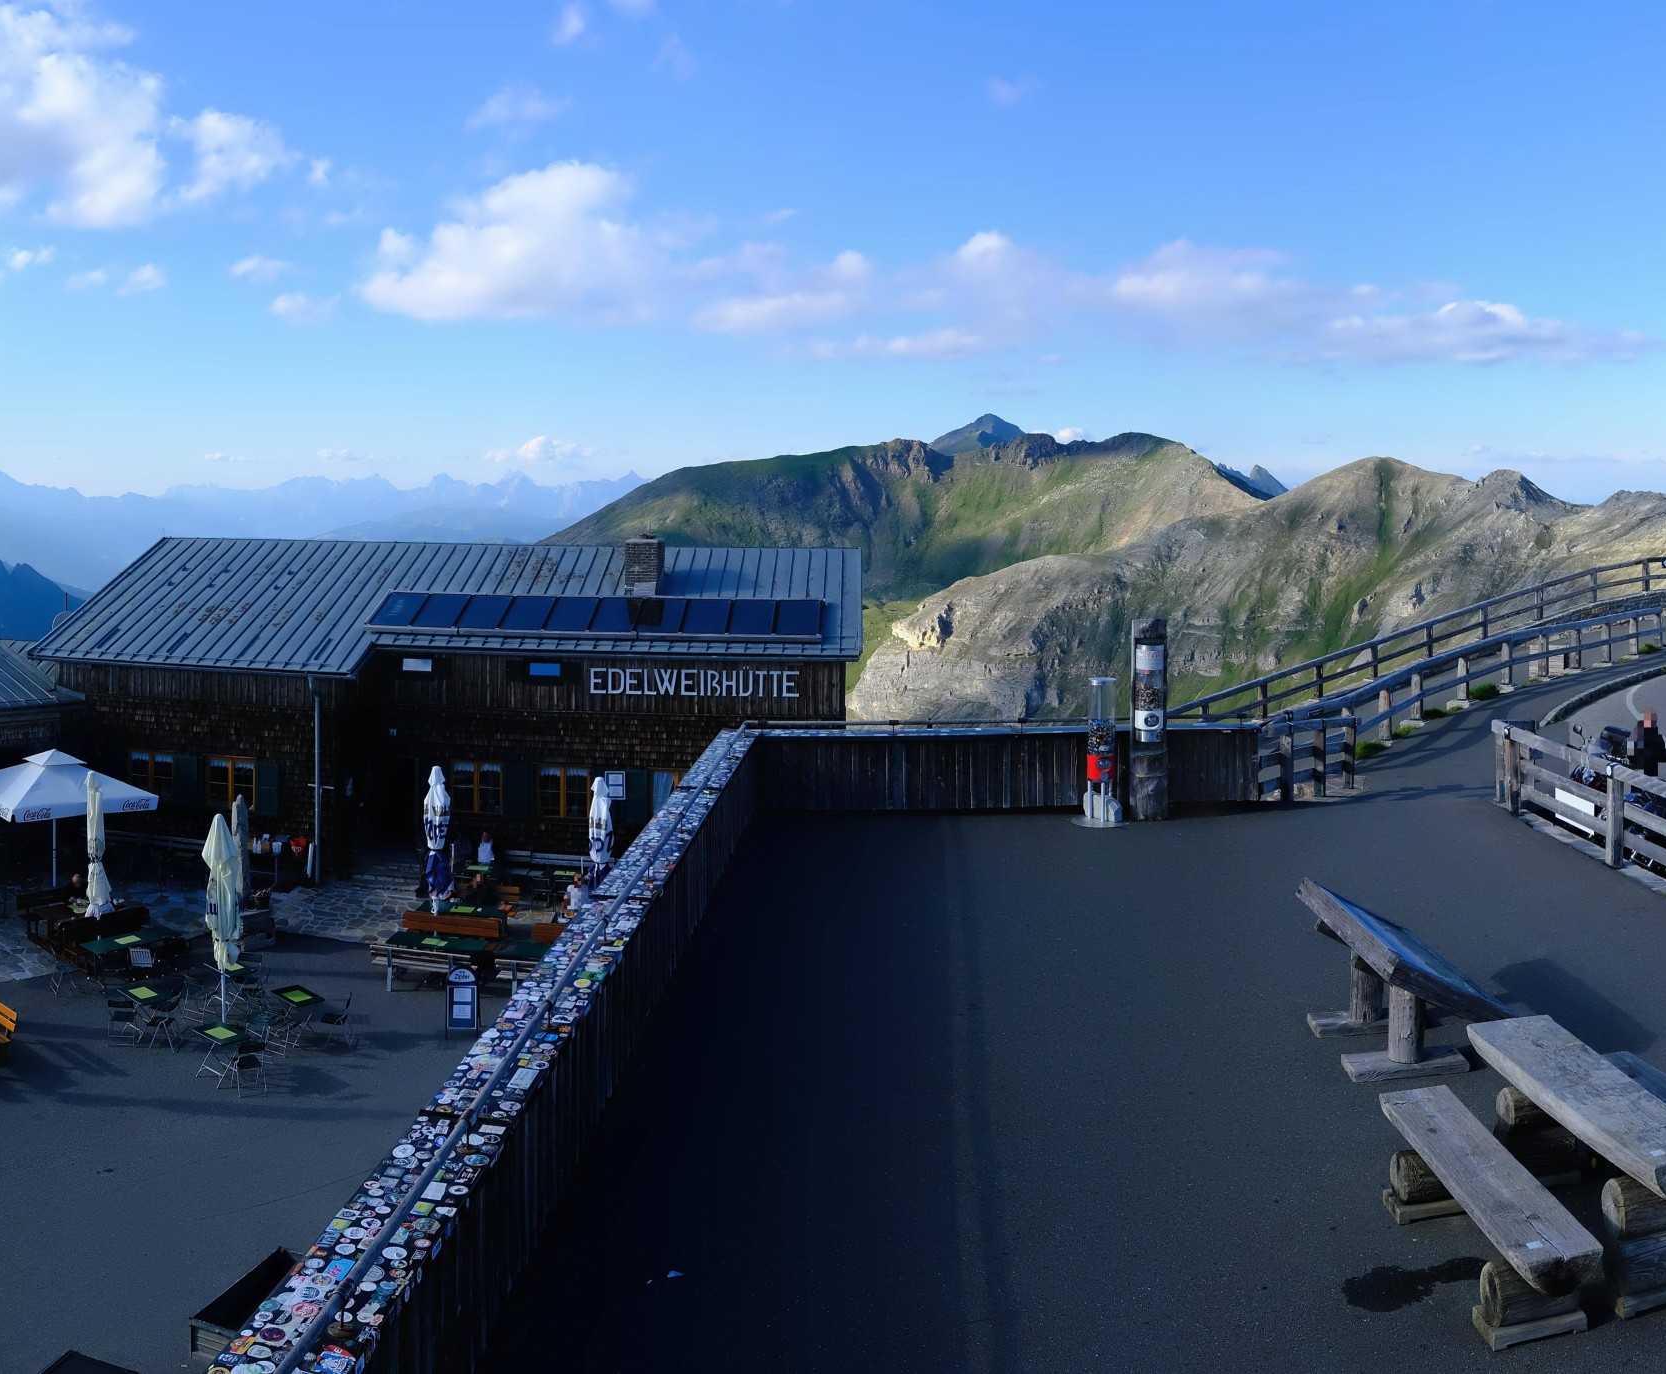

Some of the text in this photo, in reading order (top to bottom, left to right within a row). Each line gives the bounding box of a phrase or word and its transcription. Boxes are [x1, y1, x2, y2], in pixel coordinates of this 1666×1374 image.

[590, 665, 800, 698] EDELWEIßHÜTTE
[23, 807, 52, 821] Coca-Cola
[454, 973, 471, 981] Zipfer
